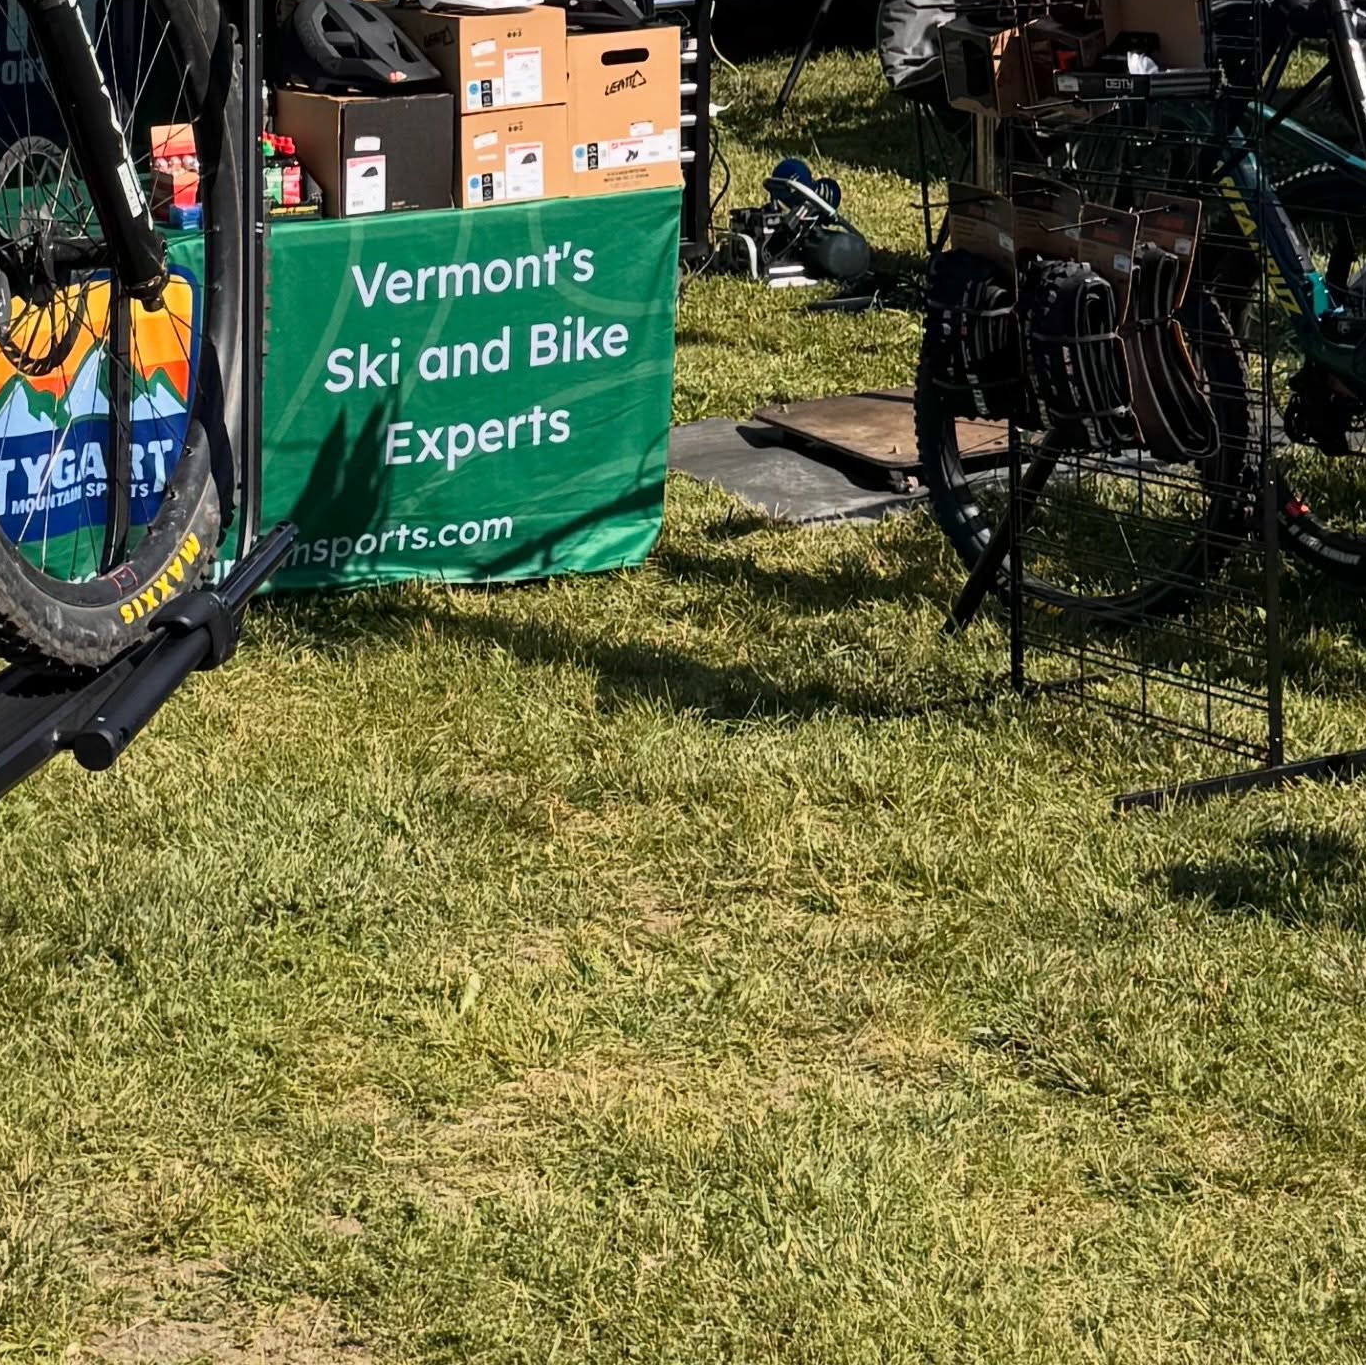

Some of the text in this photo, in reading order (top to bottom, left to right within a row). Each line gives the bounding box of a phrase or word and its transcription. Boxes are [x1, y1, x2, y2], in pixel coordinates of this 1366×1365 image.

[1105, 77, 1134, 90] DEITY
[351, 238, 596, 309] Vermont's
[325, 315, 632, 394] Ski and Bike
[384, 403, 573, 472] Experts
[85, 480, 149, 499] SPTS
[119, 532, 201, 626] MAXXIS
